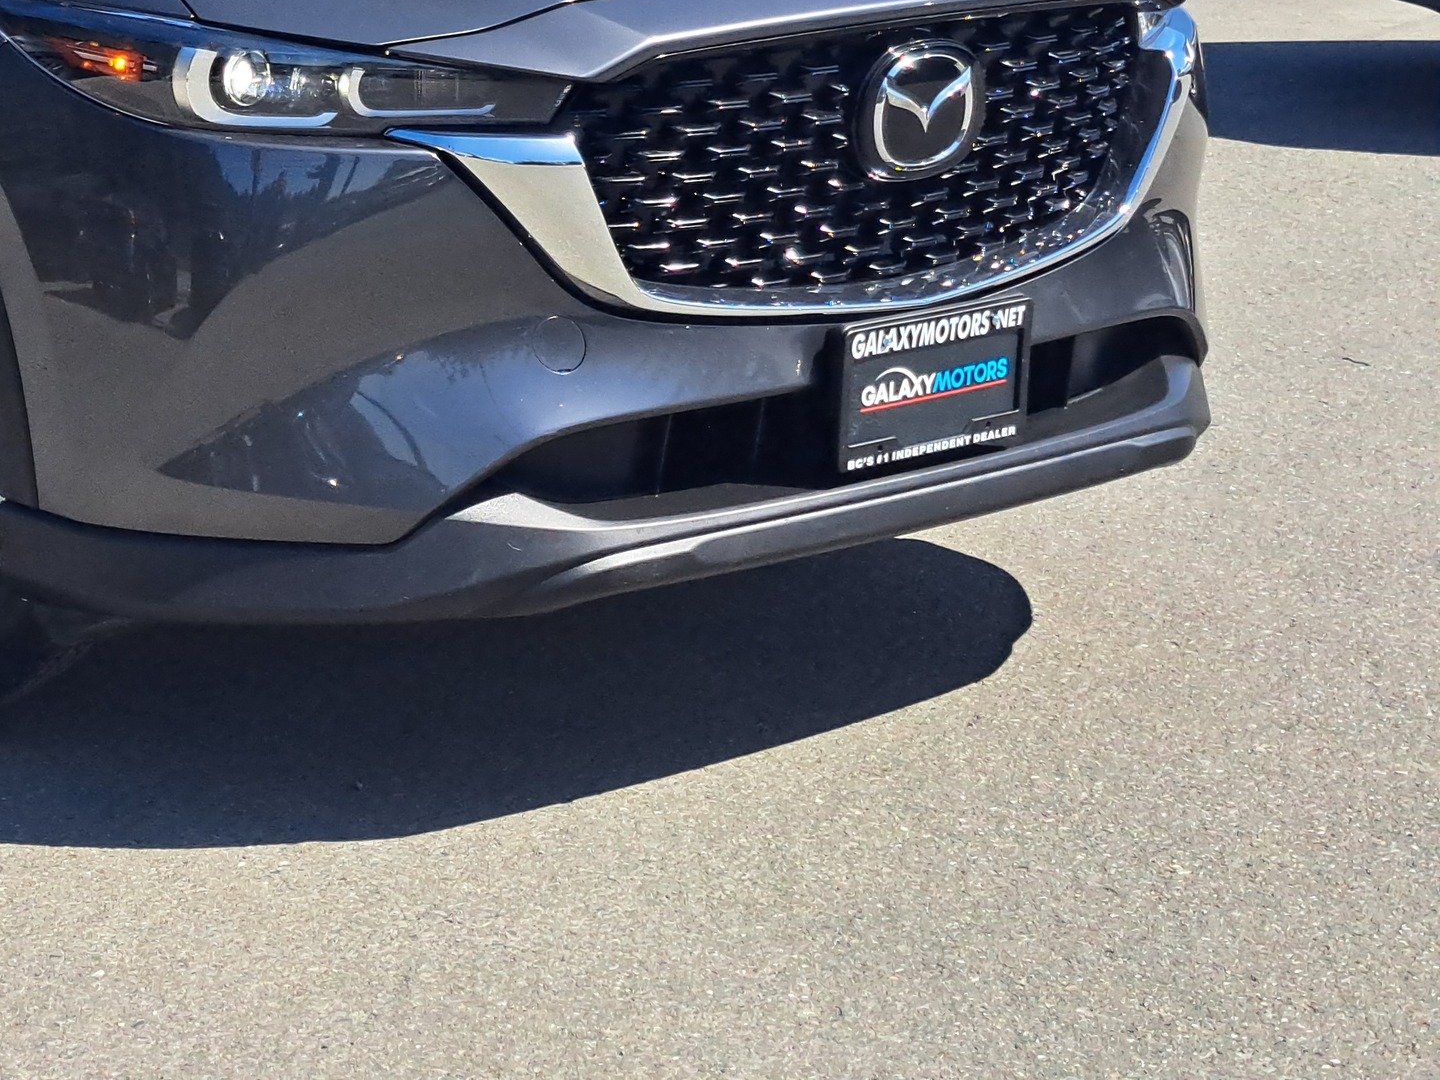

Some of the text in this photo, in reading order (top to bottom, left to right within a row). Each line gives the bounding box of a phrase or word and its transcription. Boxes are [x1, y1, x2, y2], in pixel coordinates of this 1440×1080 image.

[847, 425, 1017, 471] BC'S #1 INDEPENDENT DEALER
